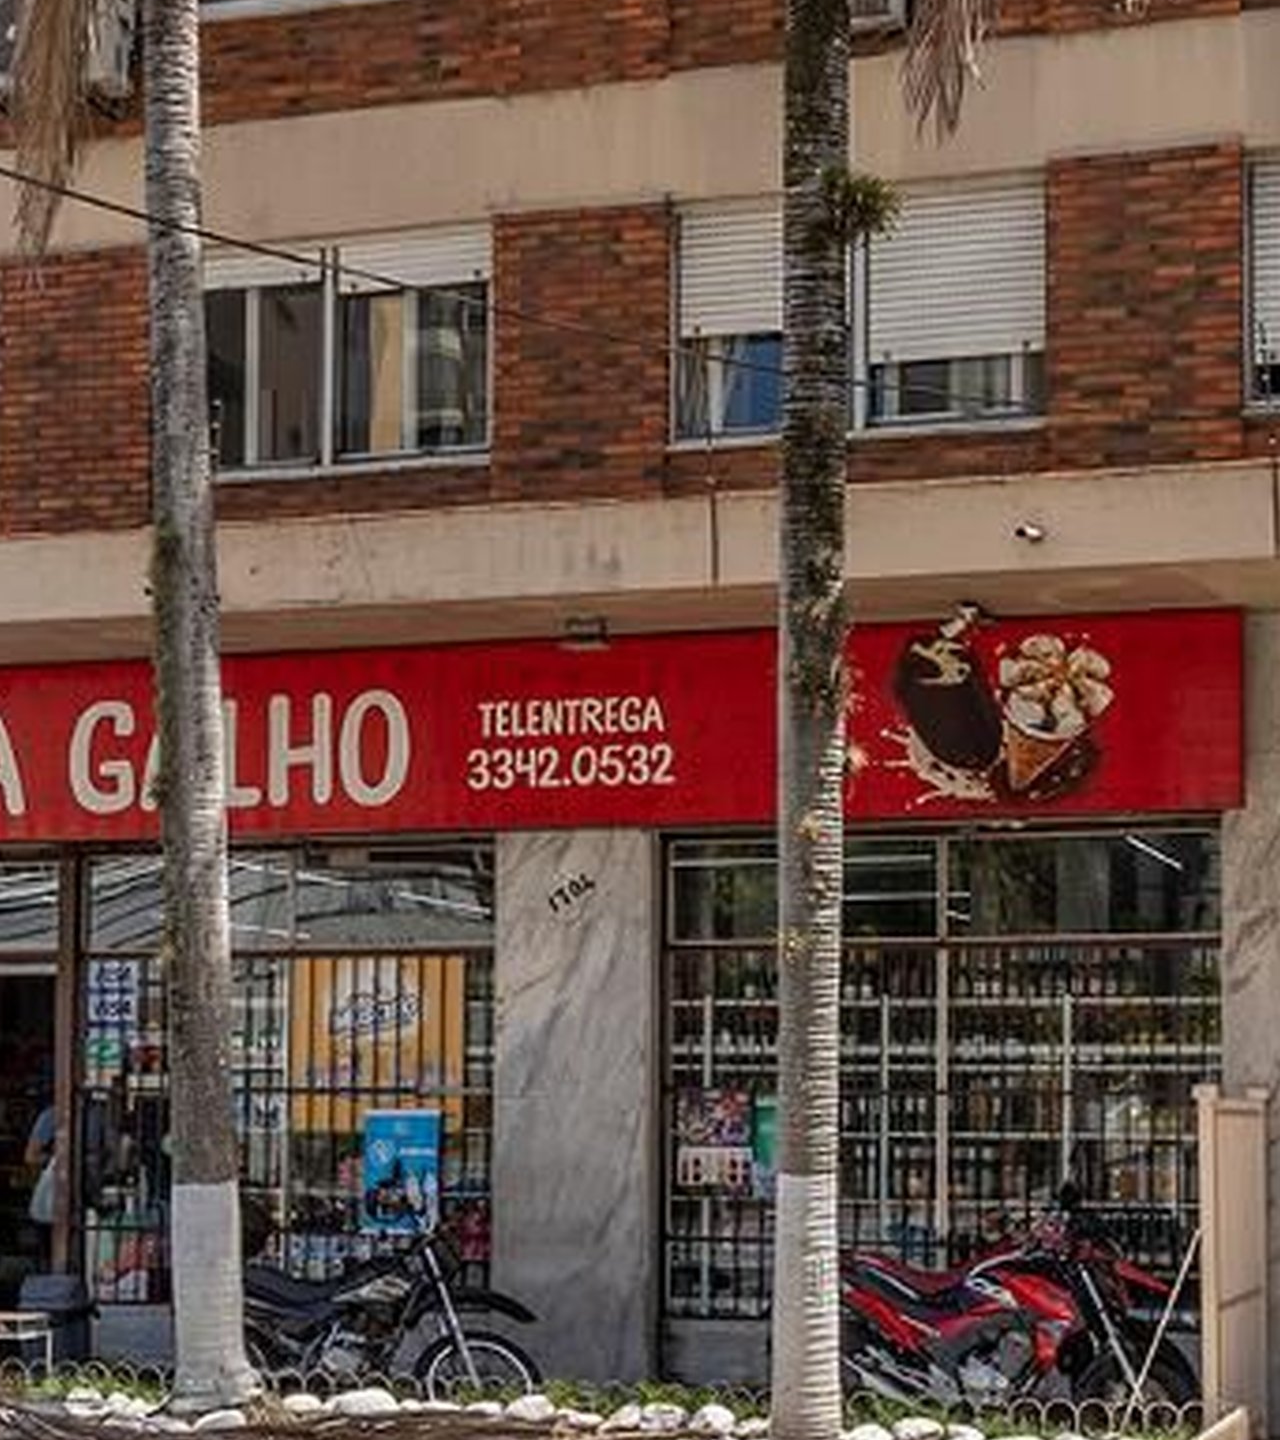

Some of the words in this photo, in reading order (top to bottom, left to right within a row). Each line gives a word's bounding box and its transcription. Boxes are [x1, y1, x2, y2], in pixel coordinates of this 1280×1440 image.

[477, 695, 665, 739] TELENTREGA
[69, 688, 410, 814] GLHO
[466, 742, 677, 790] 3342.0532
